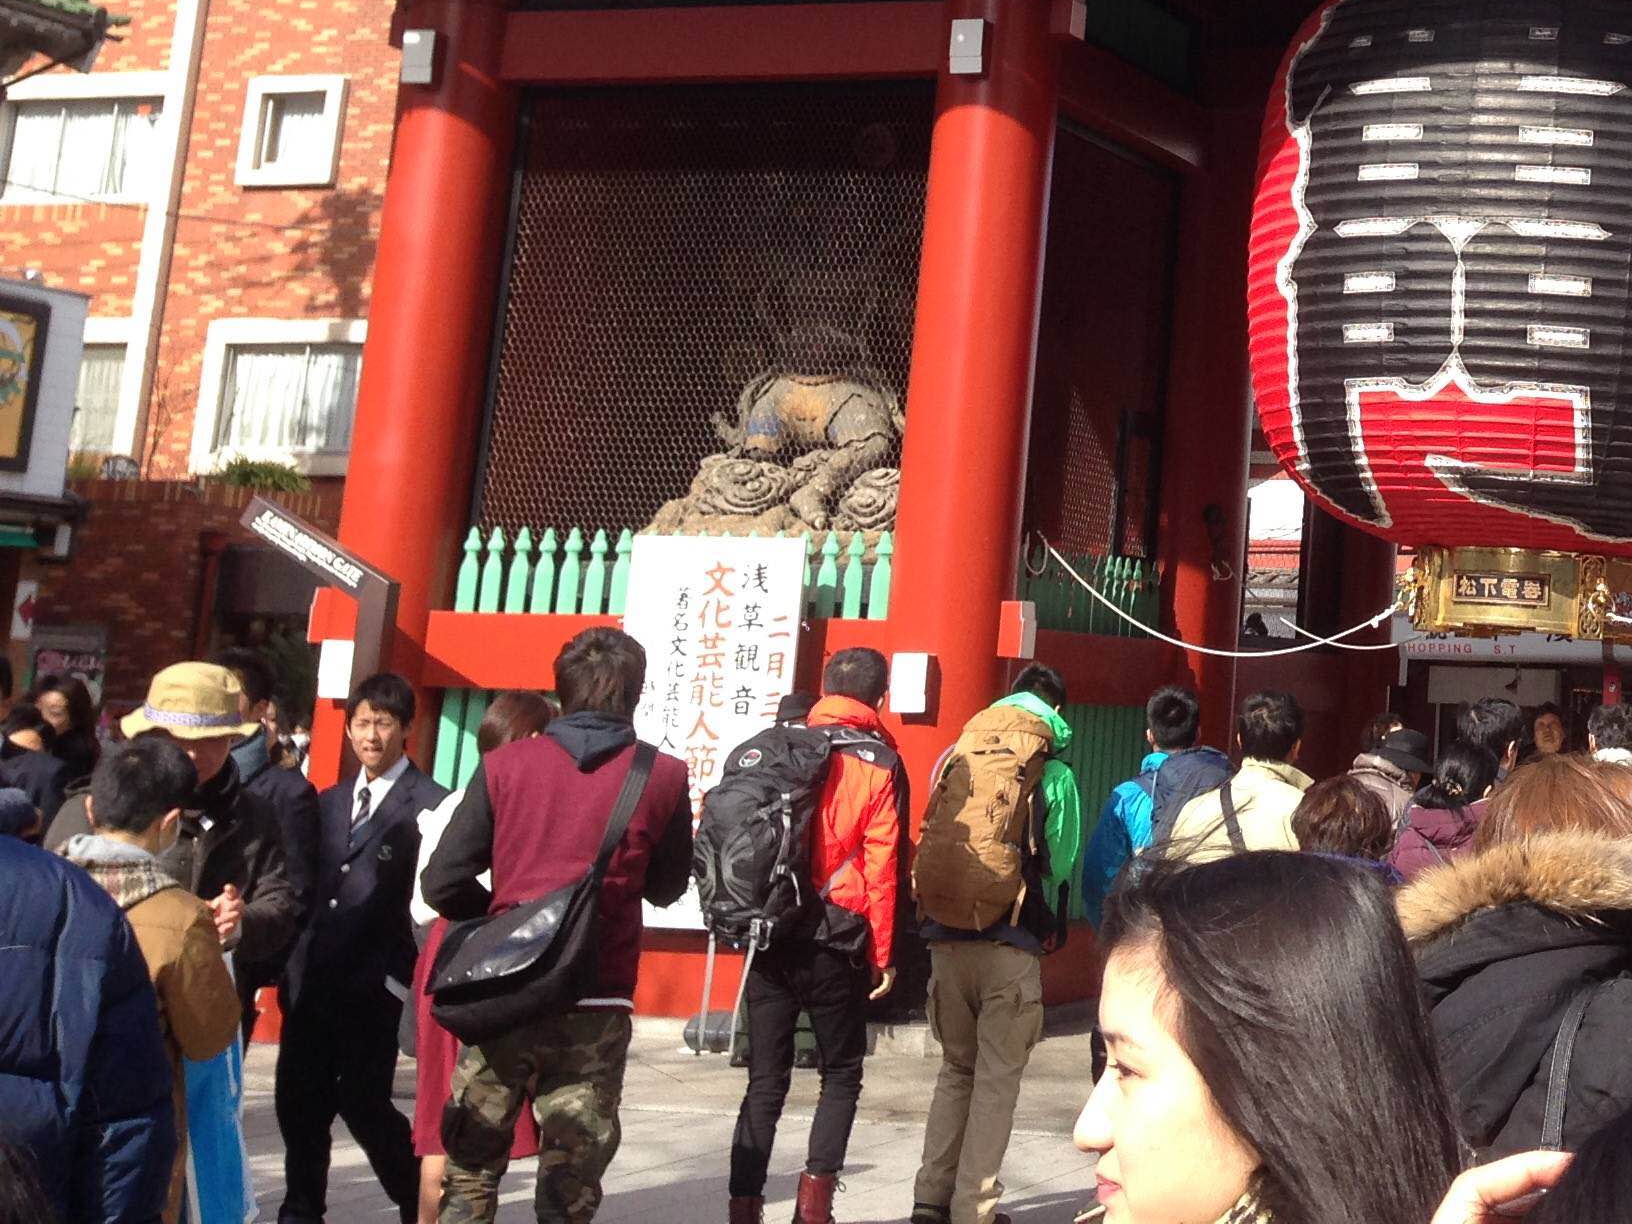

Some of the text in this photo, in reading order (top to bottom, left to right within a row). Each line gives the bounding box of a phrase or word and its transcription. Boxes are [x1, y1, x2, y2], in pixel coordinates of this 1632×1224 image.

[730, 563, 769, 717] 浅草観音
[1407, 642, 1473, 655] HOPPING
